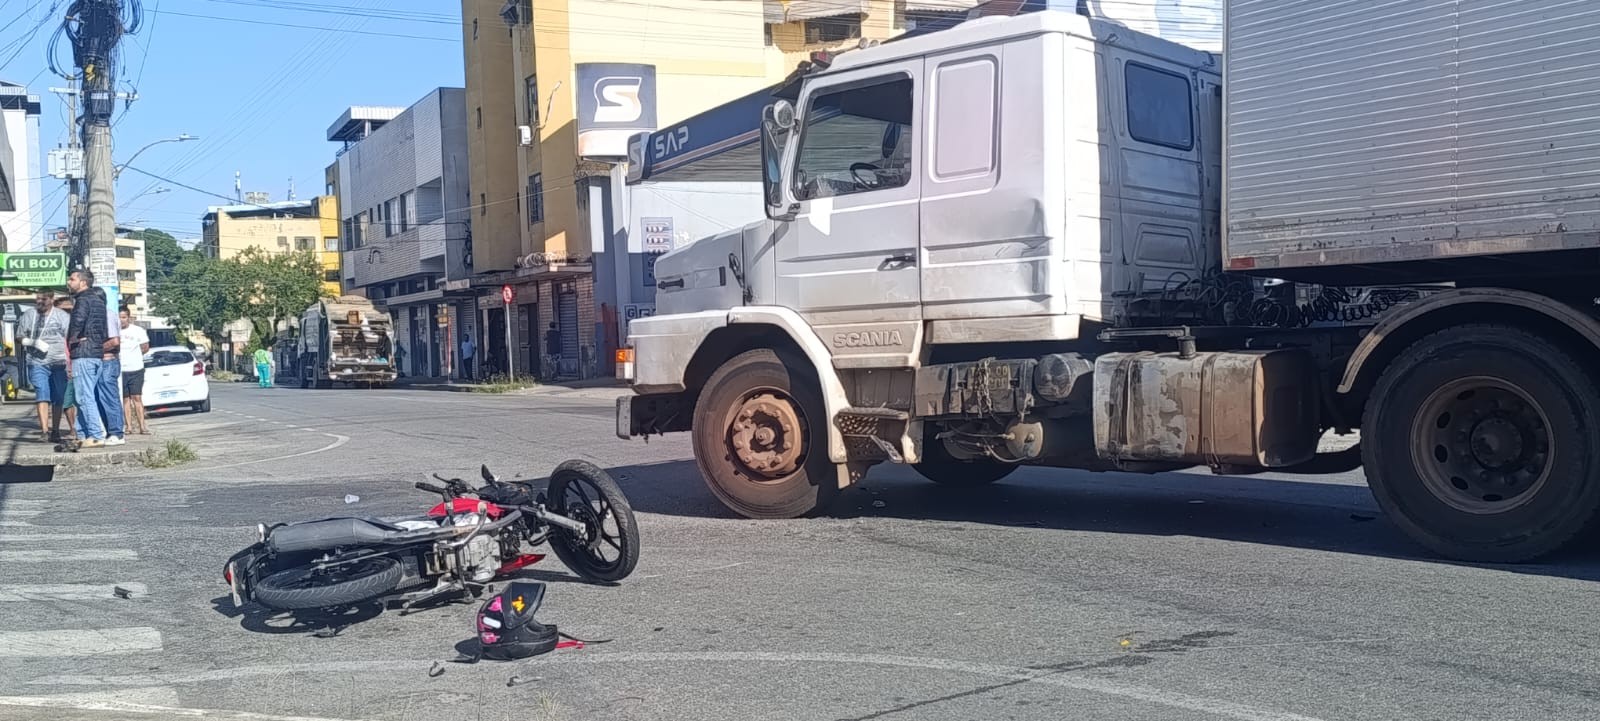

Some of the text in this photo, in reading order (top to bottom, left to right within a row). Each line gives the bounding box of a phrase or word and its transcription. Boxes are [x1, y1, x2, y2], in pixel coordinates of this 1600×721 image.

[655, 126, 689, 159] SAP
[9, 258, 59, 269] KI BOX
[833, 330, 903, 348] SCANIA
